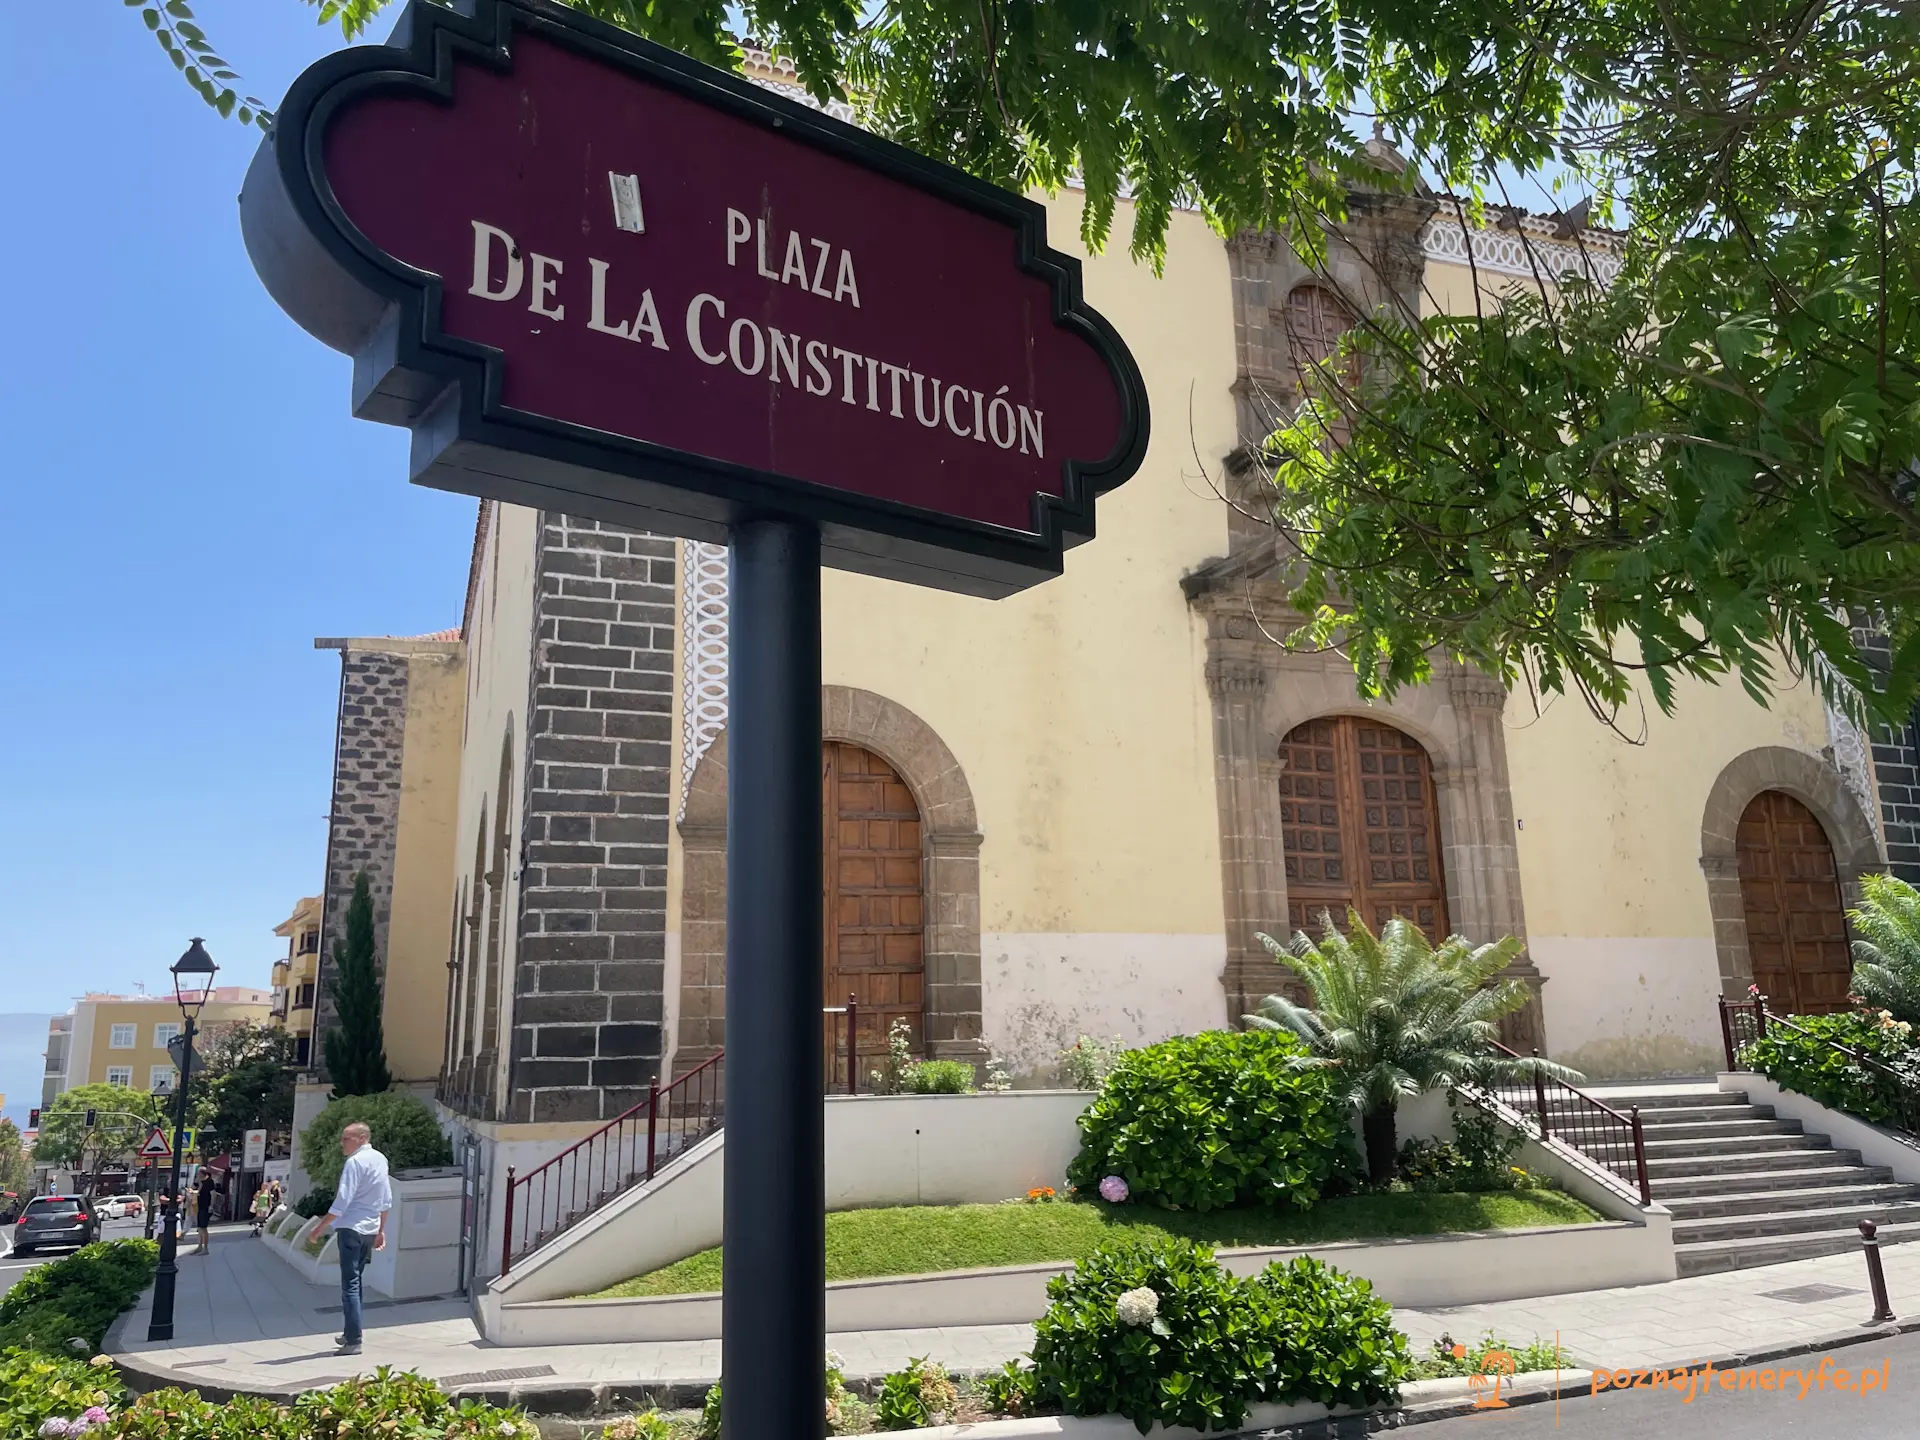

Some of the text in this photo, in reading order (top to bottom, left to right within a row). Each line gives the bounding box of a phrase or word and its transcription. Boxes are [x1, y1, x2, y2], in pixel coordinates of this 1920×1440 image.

[468, 220, 1045, 459] DE LA CONSTITUCIÓN
[728, 208, 861, 309] PLAZA
